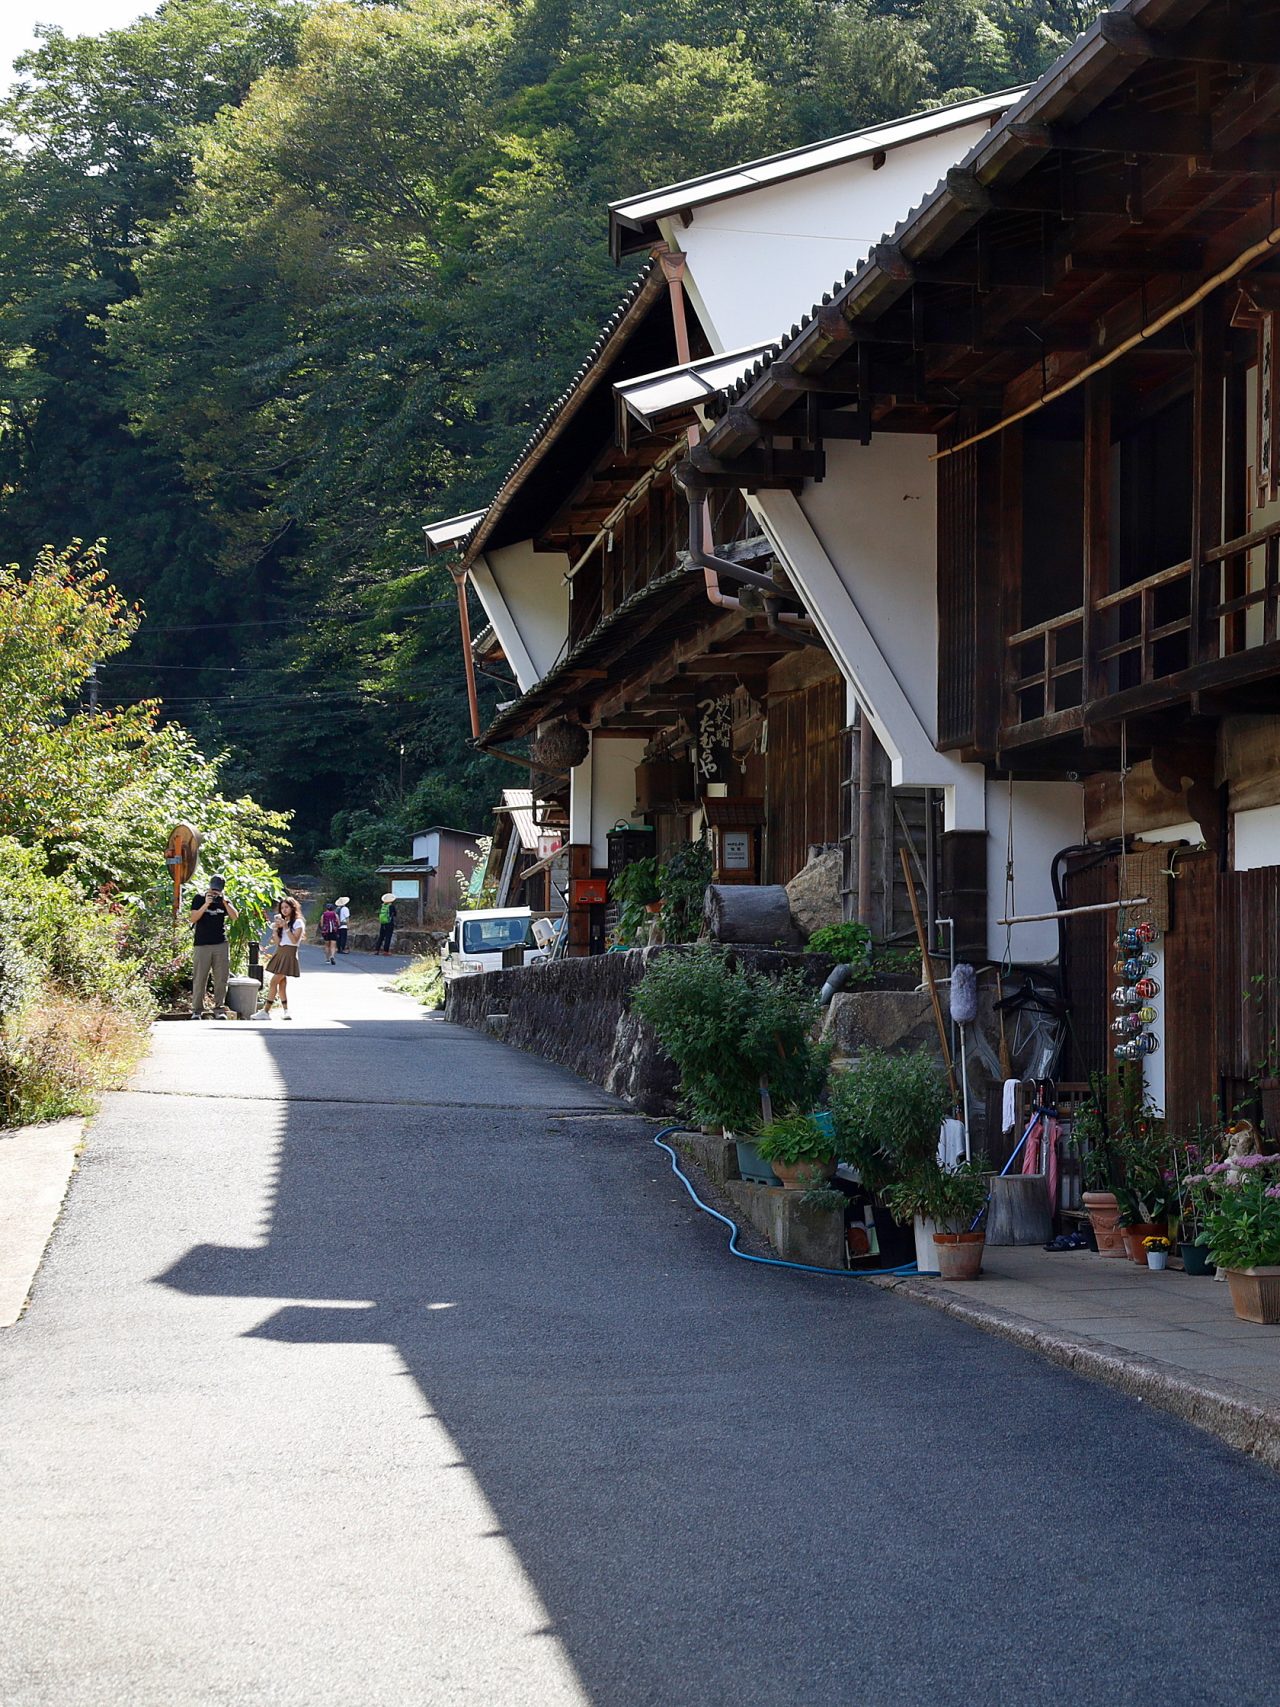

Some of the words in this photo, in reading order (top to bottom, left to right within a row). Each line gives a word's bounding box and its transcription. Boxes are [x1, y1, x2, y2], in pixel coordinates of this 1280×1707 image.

[696, 698, 718, 779] つたむらや
